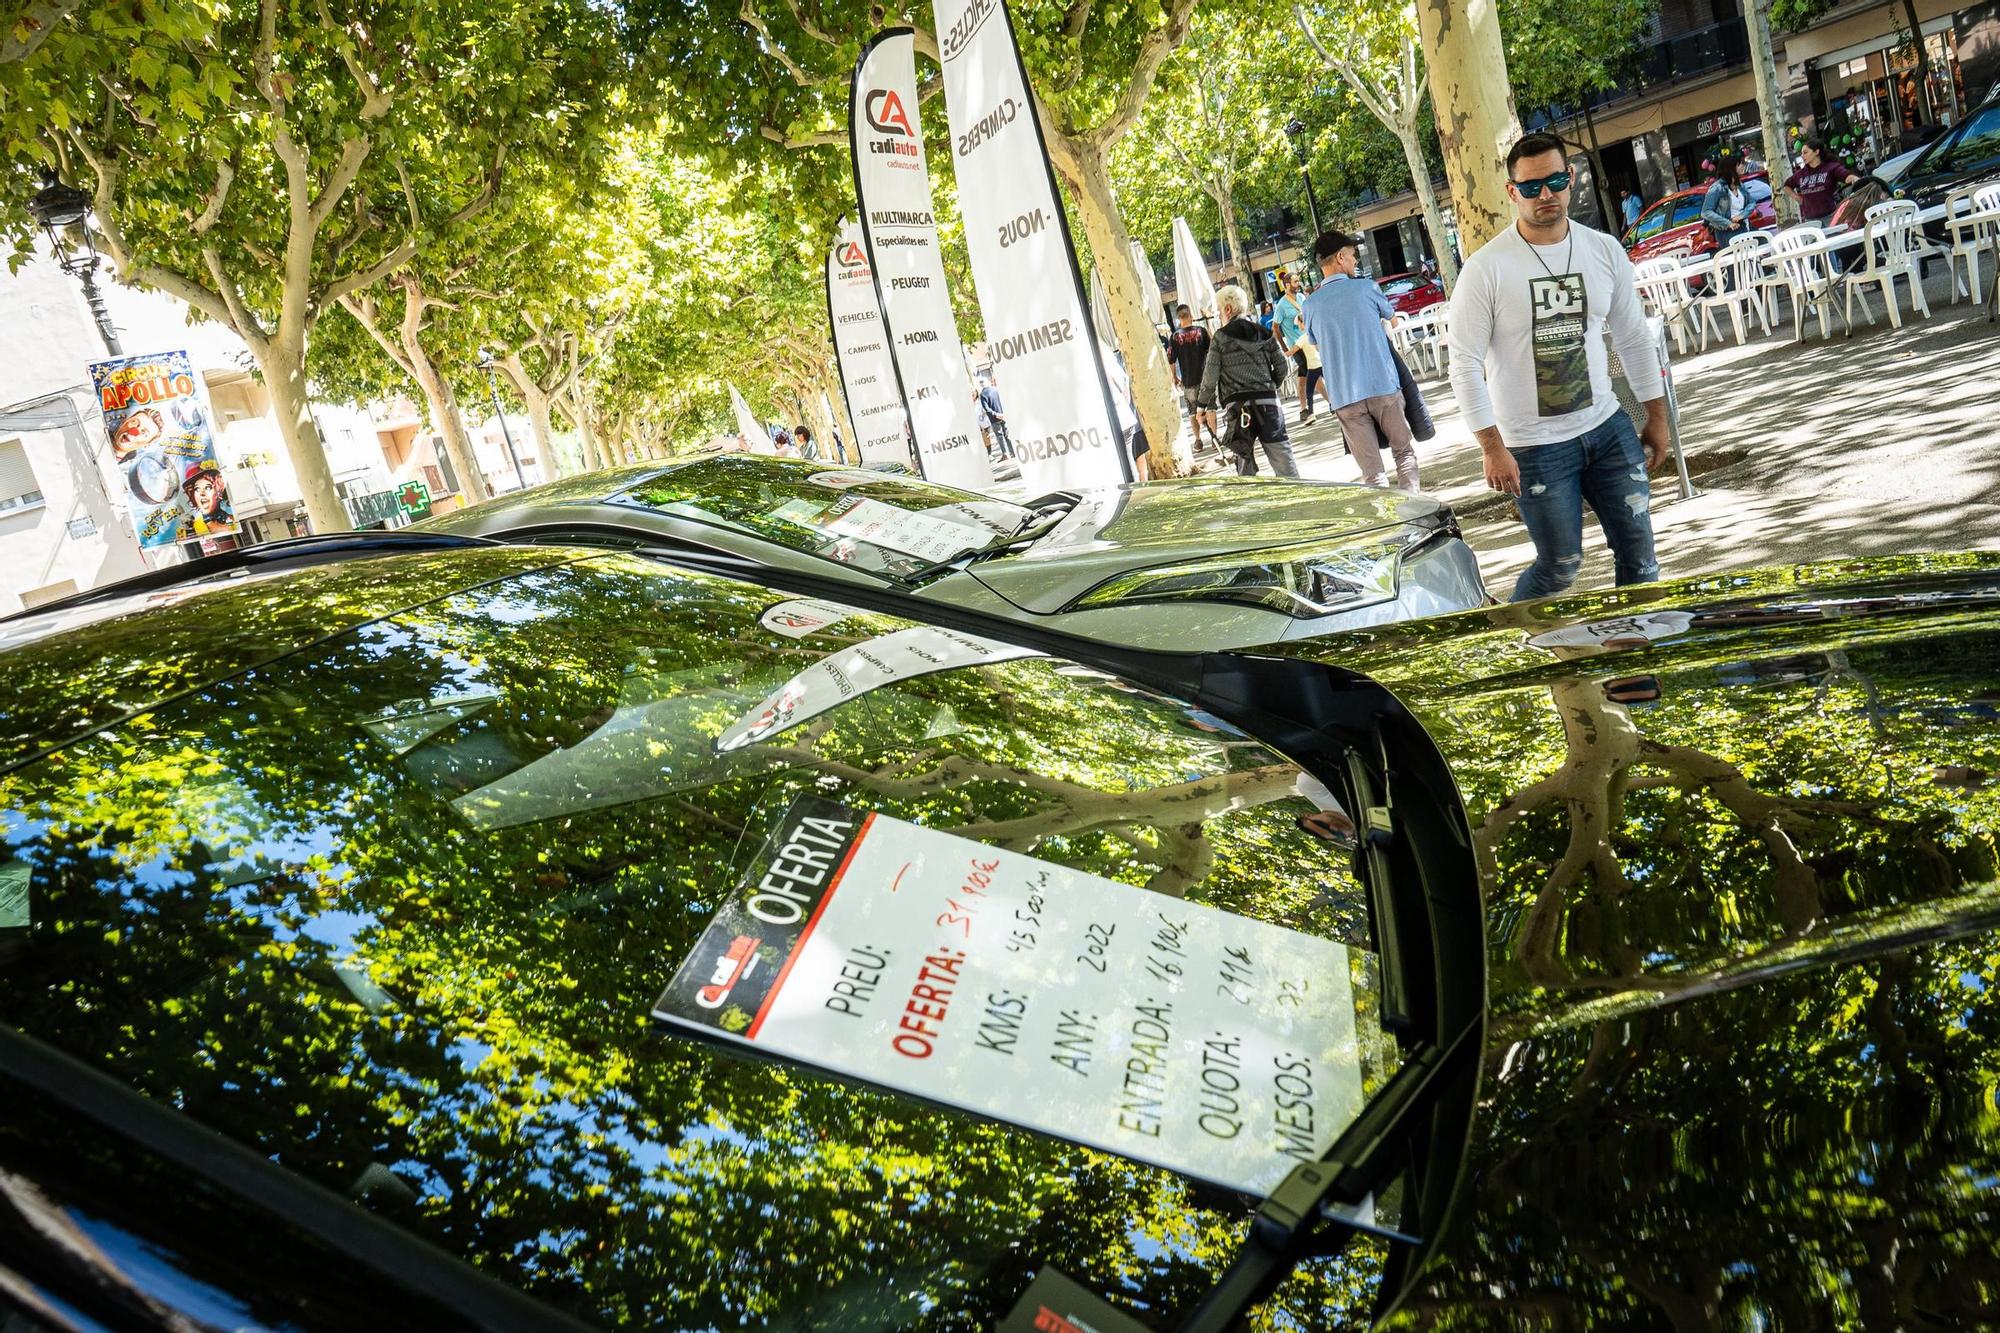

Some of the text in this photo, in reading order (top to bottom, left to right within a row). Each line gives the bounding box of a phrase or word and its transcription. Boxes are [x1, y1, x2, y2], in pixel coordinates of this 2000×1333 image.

[869, 138, 918, 156] cadiauto
[871, 211, 933, 225] MULTIMARCA
[891, 277, 930, 290] PEUGEOT
[838, 310, 879, 323] VEHICLES:
[847, 343, 881, 356] CAMPERS
[904, 330, 939, 345] HONDA
[101, 374, 195, 412] APOLLO
[854, 375, 877, 386] NOUS
[861, 406, 880, 416] SEMI
[931, 434, 970, 454] NISSAN
[745, 816, 853, 925] OFERTA
[825, 945, 891, 1018] PREU:
[892, 946, 967, 1060] OFERTA:
[1051, 923, 1116, 1077] ANY: 2022
[974, 988, 1029, 1055] KMS:
[1119, 997, 1173, 1138] ENTRADA:
[1198, 1031, 1243, 1140] QUOTA:
[1274, 1052, 1314, 1164] MESOS:
